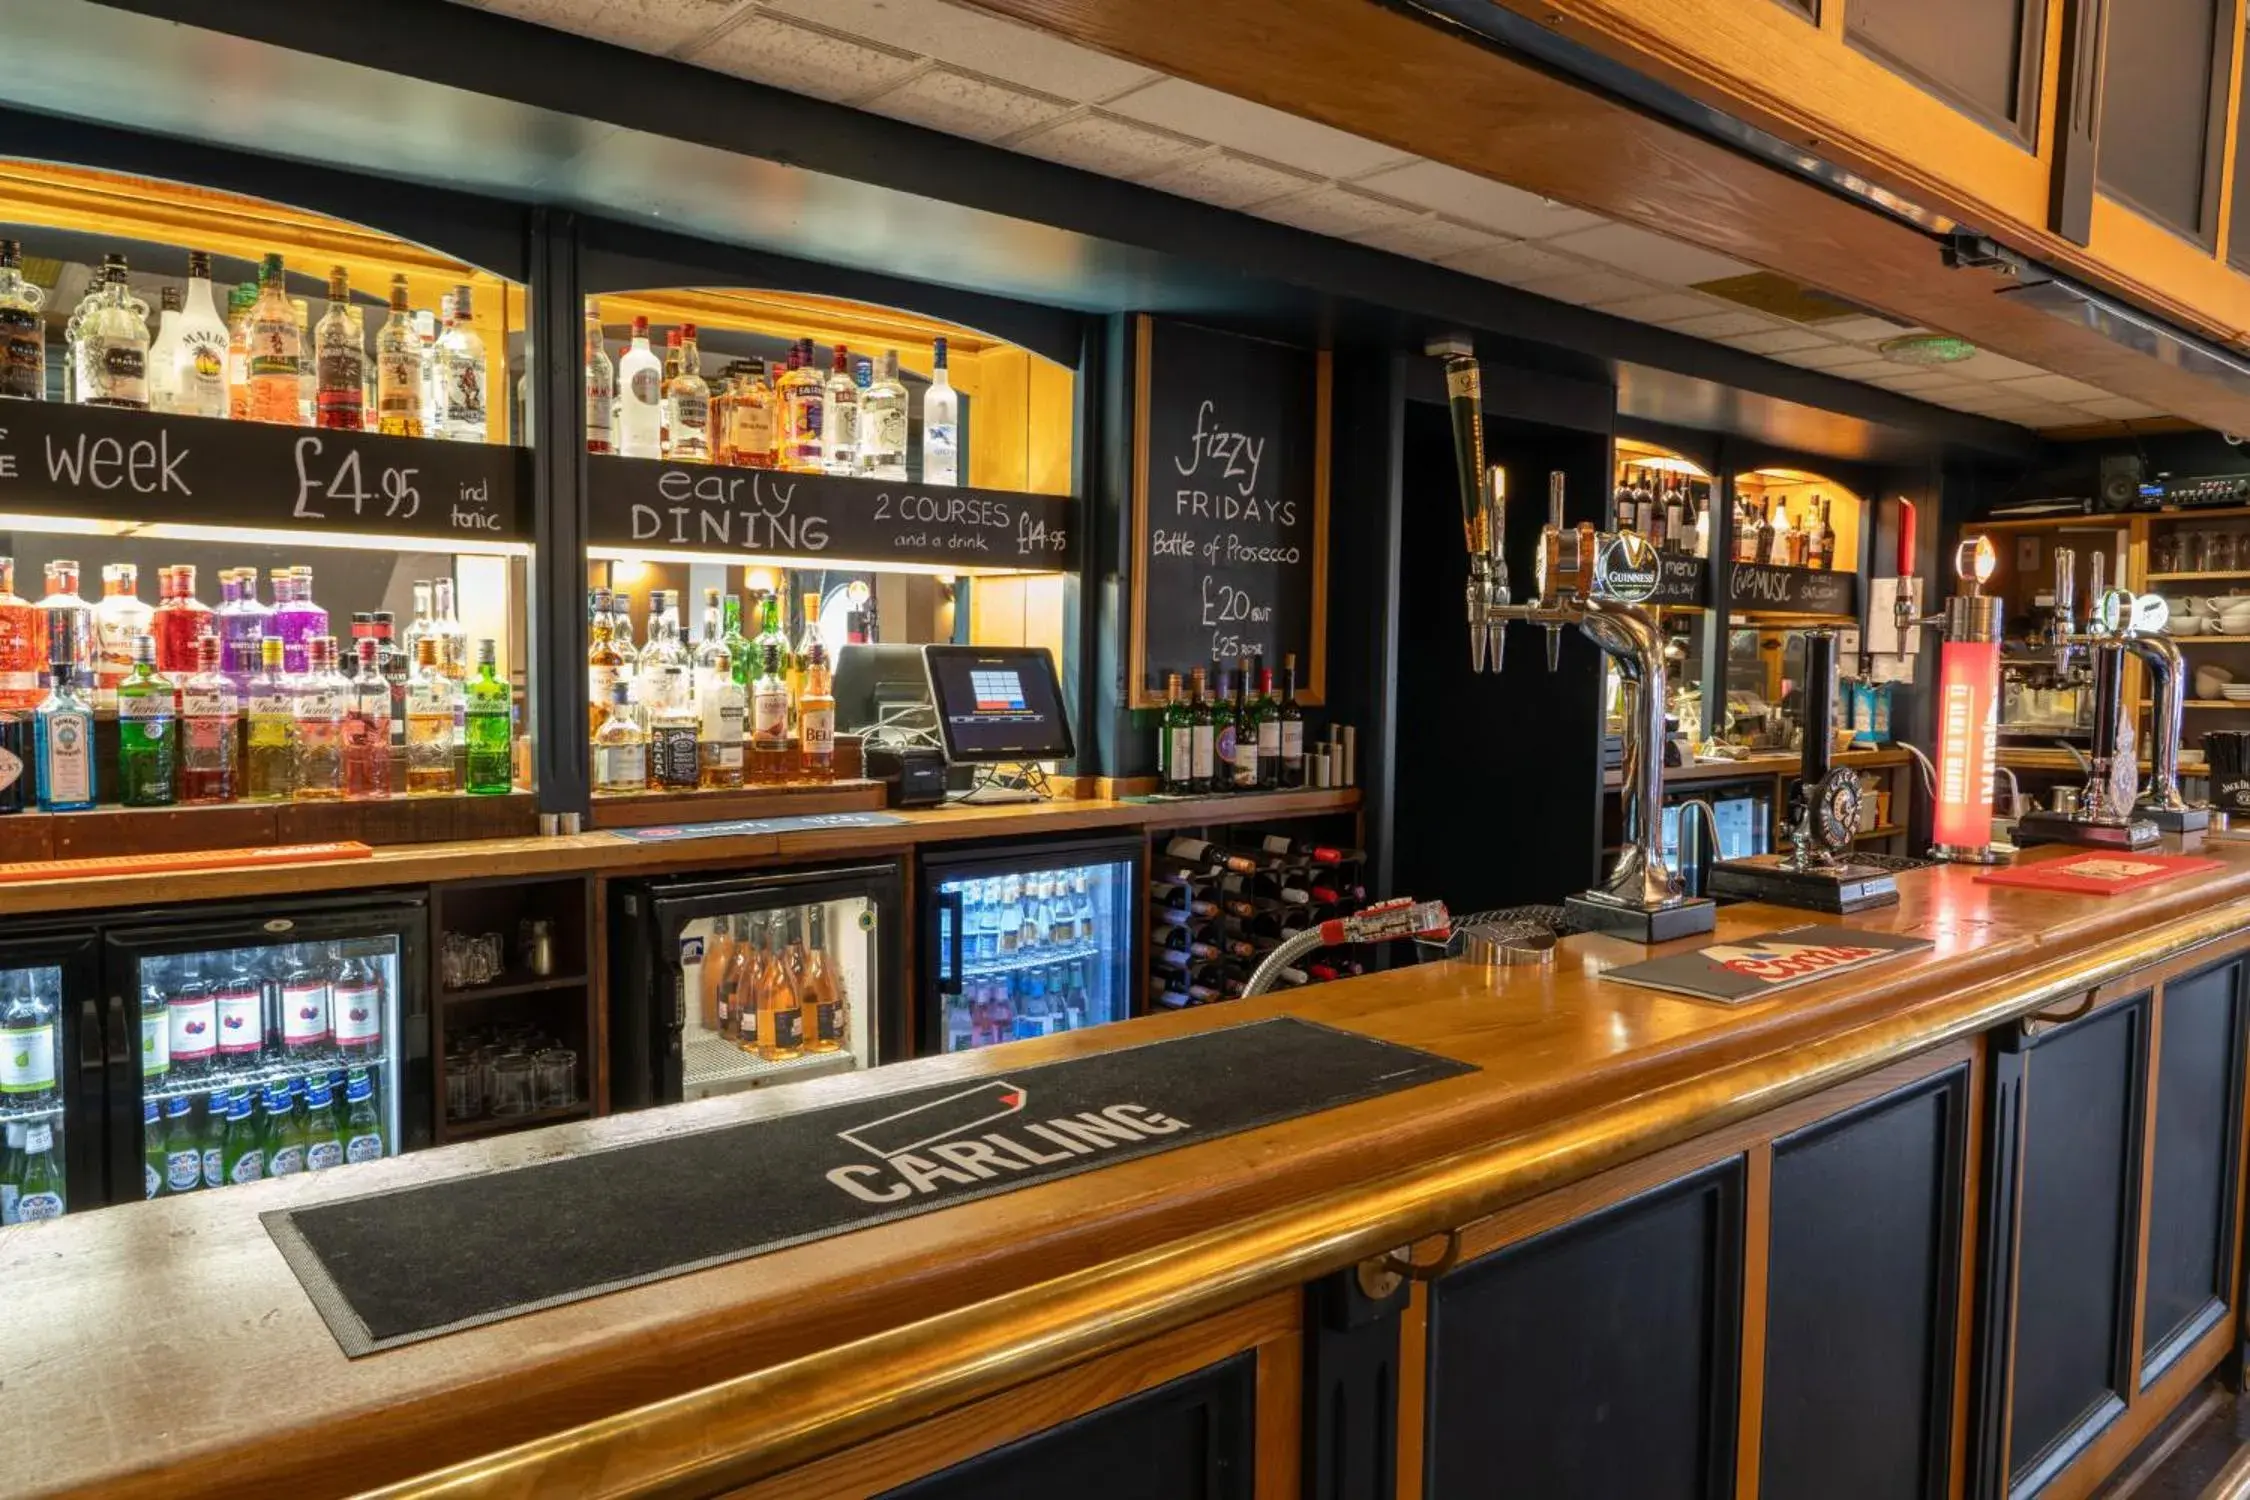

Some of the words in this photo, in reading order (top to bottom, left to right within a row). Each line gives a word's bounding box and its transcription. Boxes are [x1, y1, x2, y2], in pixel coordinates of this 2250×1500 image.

[44, 430, 192, 496] week
[1174, 399, 1265, 496] fizzy
[293, 436, 421, 518] £4.95
[658, 470, 797, 518] early
[450, 504, 502, 531] tonic
[631, 503, 830, 551] DINING
[873, 493, 892, 521] 2
[899, 495, 1011, 528] COURSES
[1175, 489, 1297, 526] FRIDAYS
[894, 532, 926, 547] and
[931, 536, 942, 547] a
[947, 532, 990, 551] drink
[1152, 528, 1197, 557] Bottle
[1202, 534, 1222, 566] of
[1226, 533, 1300, 565] Prosecco
[1608, 570, 1655, 583] GUINNESS
[1202, 575, 1250, 626] £20
[1211, 630, 1241, 662] £25
[825, 1103, 1194, 1204] CARLING
